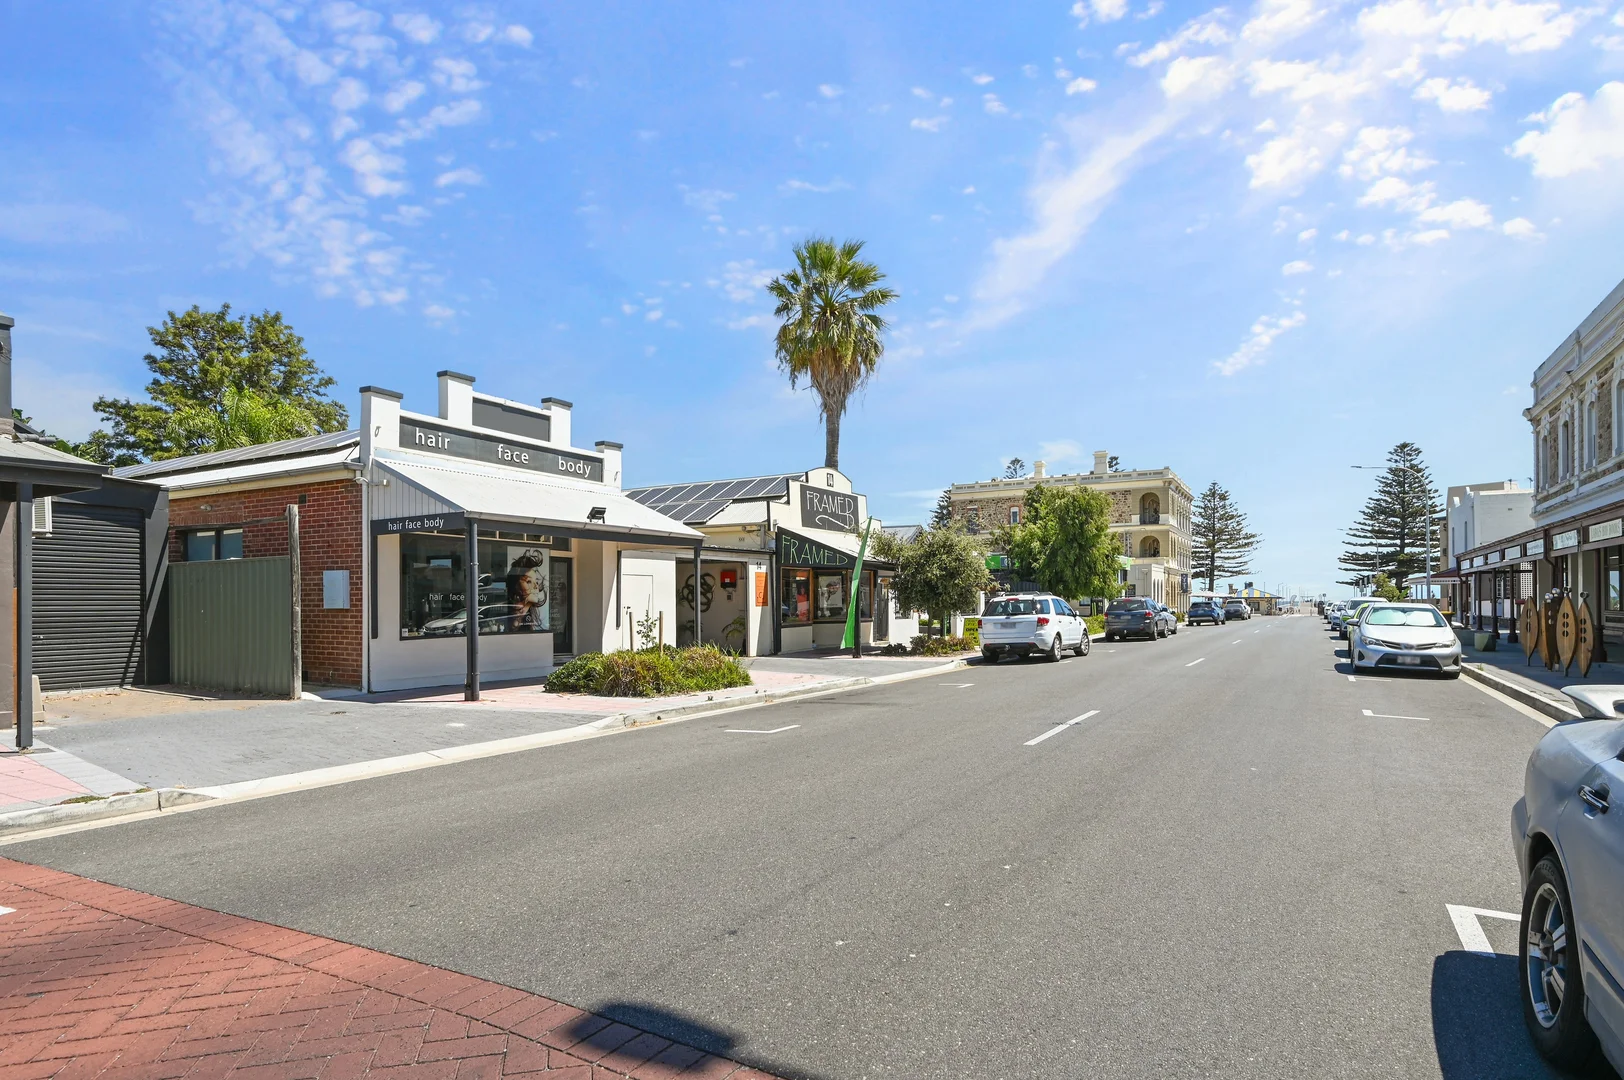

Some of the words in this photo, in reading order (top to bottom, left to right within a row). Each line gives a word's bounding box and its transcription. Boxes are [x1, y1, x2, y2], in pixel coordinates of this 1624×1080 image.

[415, 428, 450, 449] hair
[497, 444, 529, 464] face
[558, 456, 591, 477] body
[806, 490, 854, 516] FRAMED
[388, 521, 402, 530] hair
[405, 519, 421, 529] face
[424, 517, 444, 528] body
[781, 534, 848, 565] FRAMED
[756, 561, 762, 570] 14
[429, 592, 443, 600] hair
[449, 592, 465, 600] face
